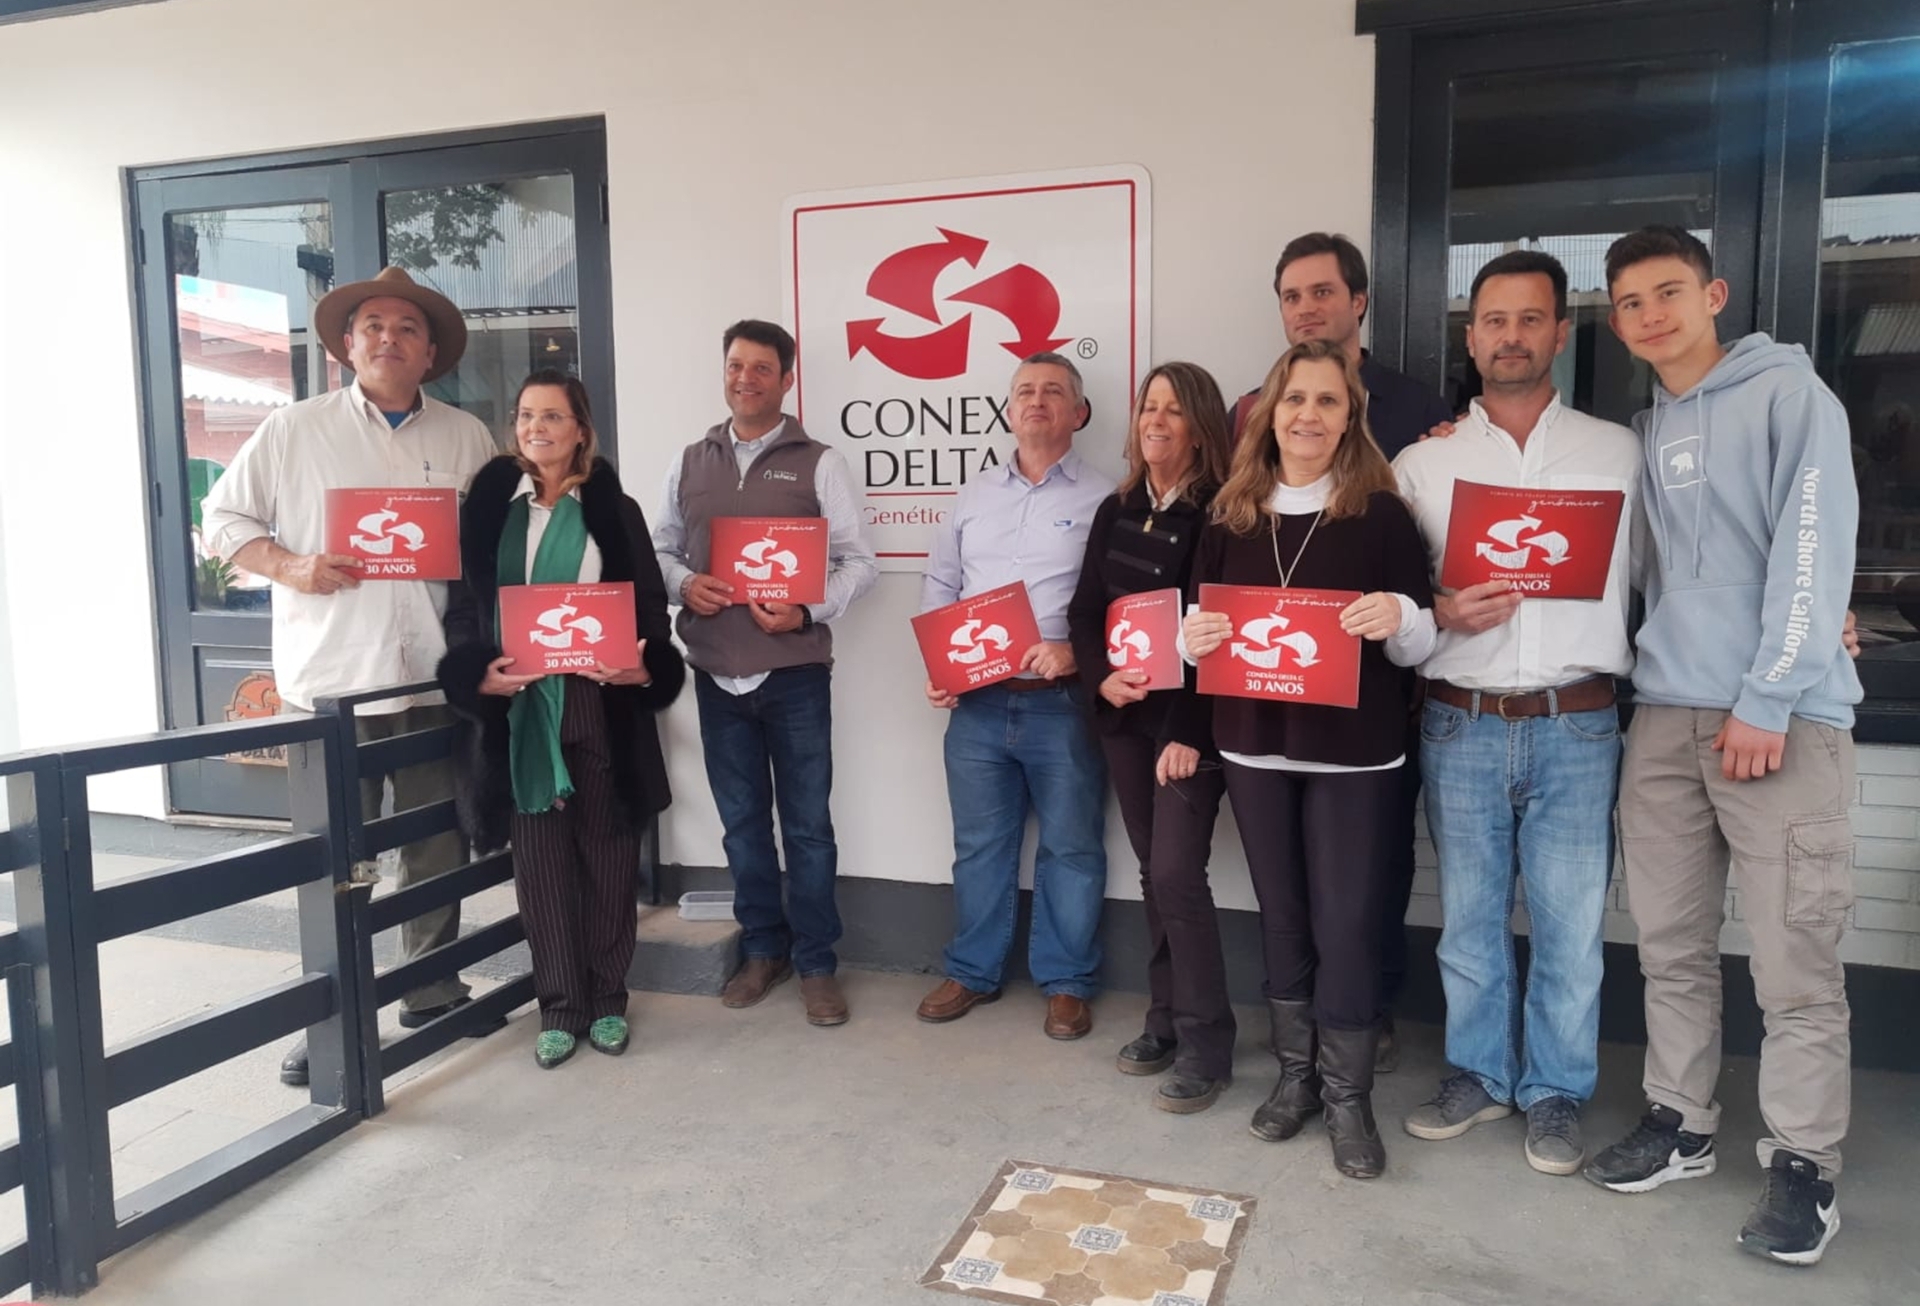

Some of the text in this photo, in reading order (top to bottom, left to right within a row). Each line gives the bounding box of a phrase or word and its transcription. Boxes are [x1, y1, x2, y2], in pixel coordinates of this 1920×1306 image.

[364, 563, 417, 574] 30 ANOS
[1765, 466, 1821, 683] North Shore California
[1509, 579, 1551, 591] ANOS
[760, 588, 790, 599] ANOS
[543, 655, 596, 669] 30 ANOS
[982, 661, 1012, 680] ANOS
[1244, 678, 1305, 696] 30 ANOS
